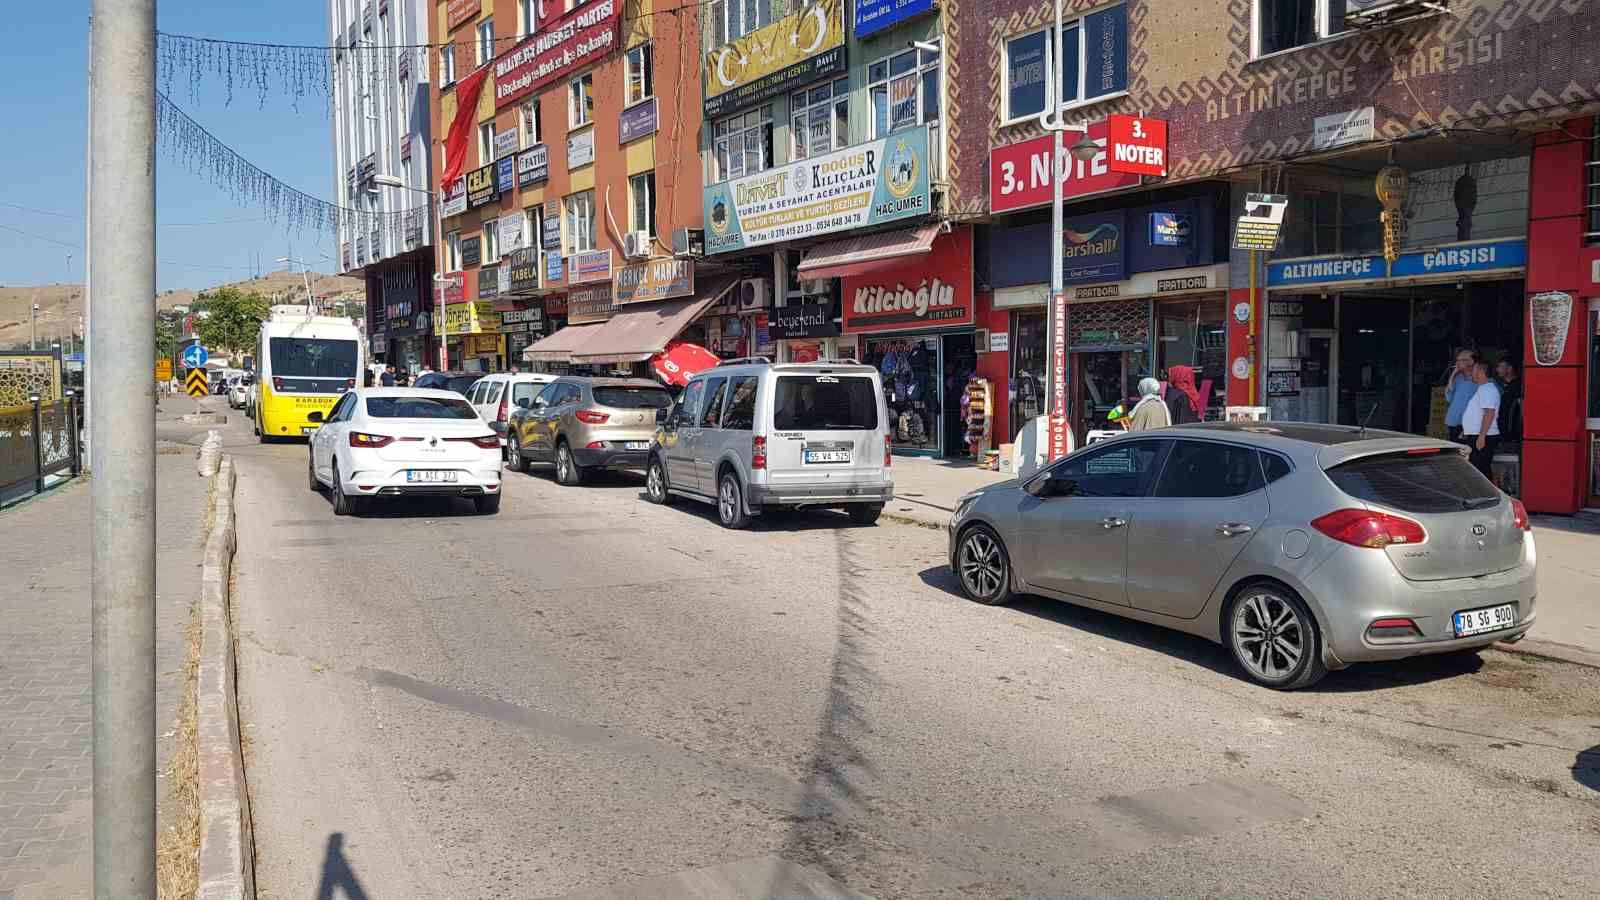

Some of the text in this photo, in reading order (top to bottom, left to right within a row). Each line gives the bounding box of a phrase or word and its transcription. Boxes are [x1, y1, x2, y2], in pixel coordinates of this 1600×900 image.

[1132, 120, 1147, 139] 3.
[1115, 143, 1164, 166] NOTER
[1001, 161, 1024, 196] 3.
[738, 204, 767, 217] TURİZM
[776, 194, 815, 208] SEYAHAT
[817, 178, 876, 200] ACENTALARI
[876, 195, 922, 216] HAC UMRE
[511, 266, 537, 281] TABELA
[653, 259, 690, 282] MARKET
[1283, 247, 1496, 279] ALTINKEPÇE ÇARŞISI
[1460, 614, 1474, 631] 78
[1478, 610, 1490, 627] SG
[1494, 606, 1512, 623] 900
